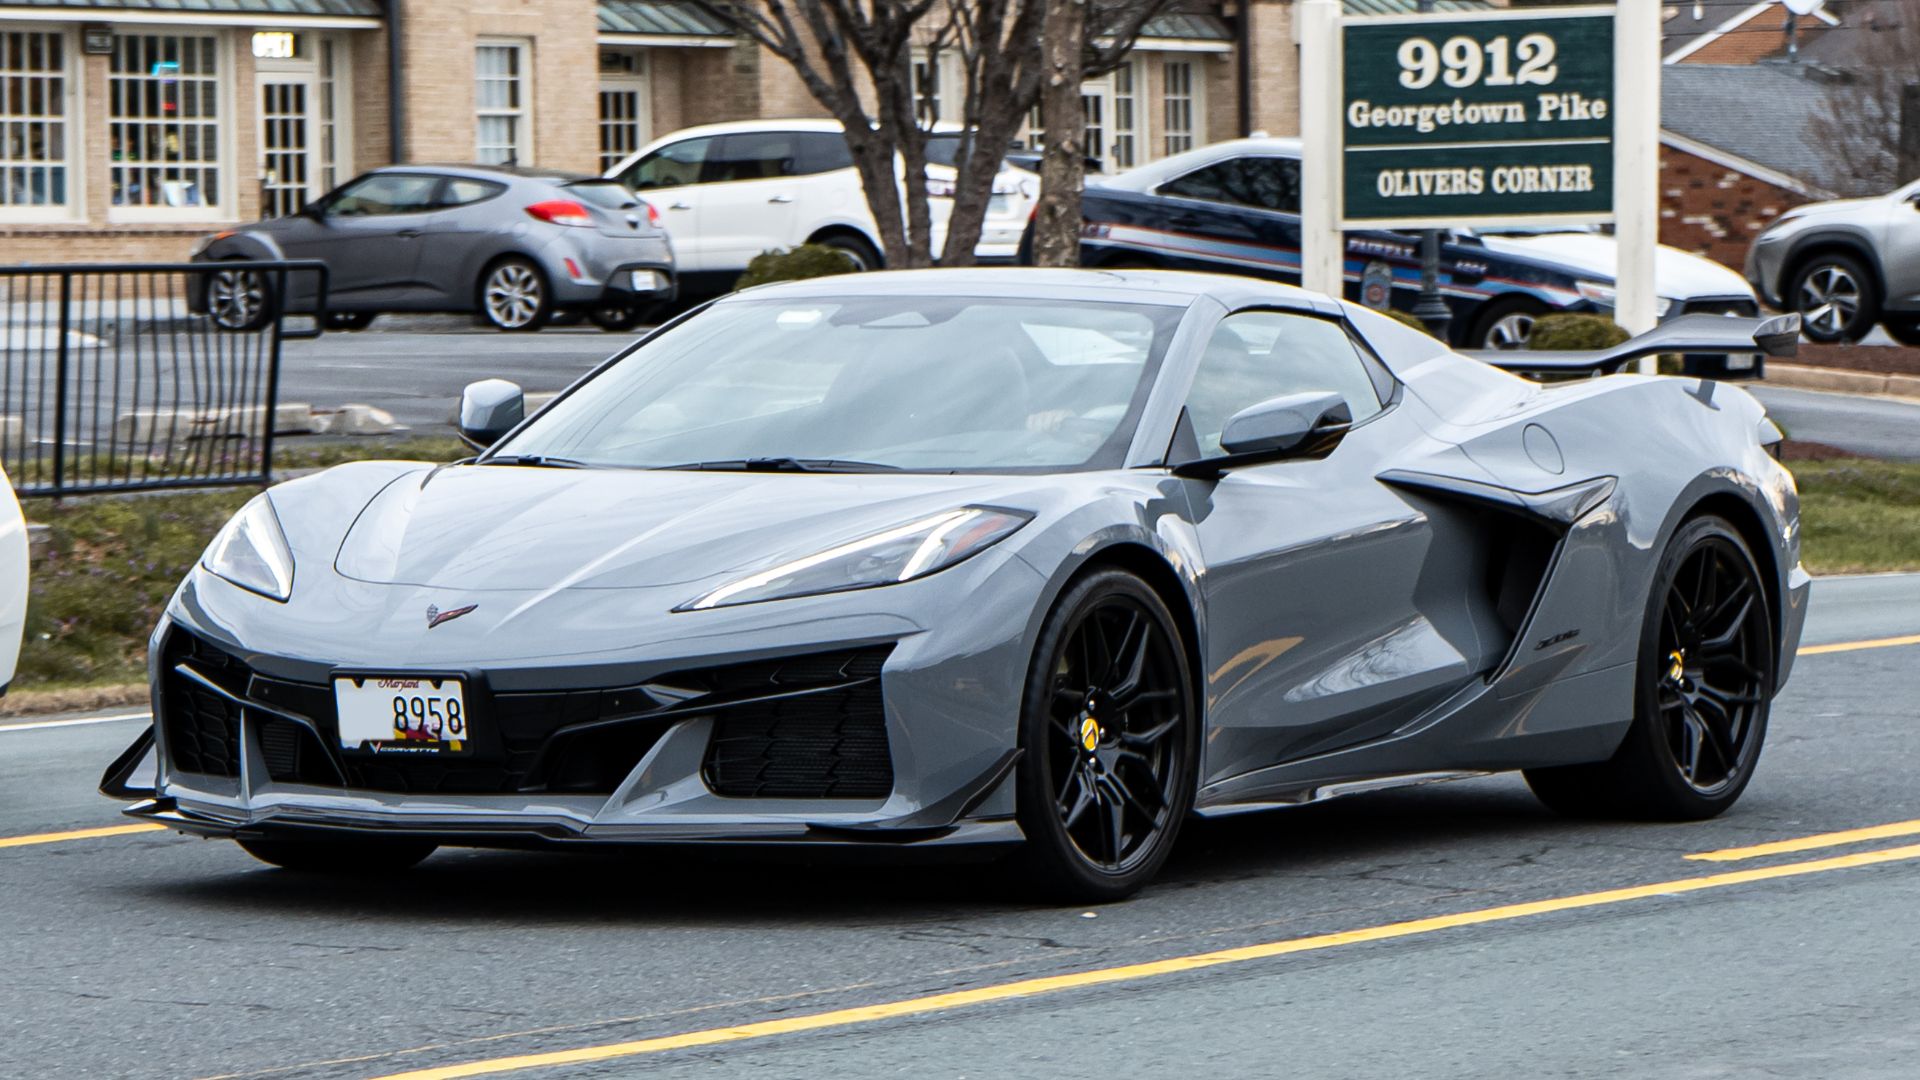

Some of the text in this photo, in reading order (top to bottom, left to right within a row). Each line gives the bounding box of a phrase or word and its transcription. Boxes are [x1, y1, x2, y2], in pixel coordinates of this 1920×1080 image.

[1397, 33, 1558, 89] 9912
[1348, 92, 1607, 133] Georgetown Pike
[1377, 165, 1593, 197] OLIVERS CORNER
[378, 679, 420, 692] Maryland
[393, 696, 463, 734] 8958
